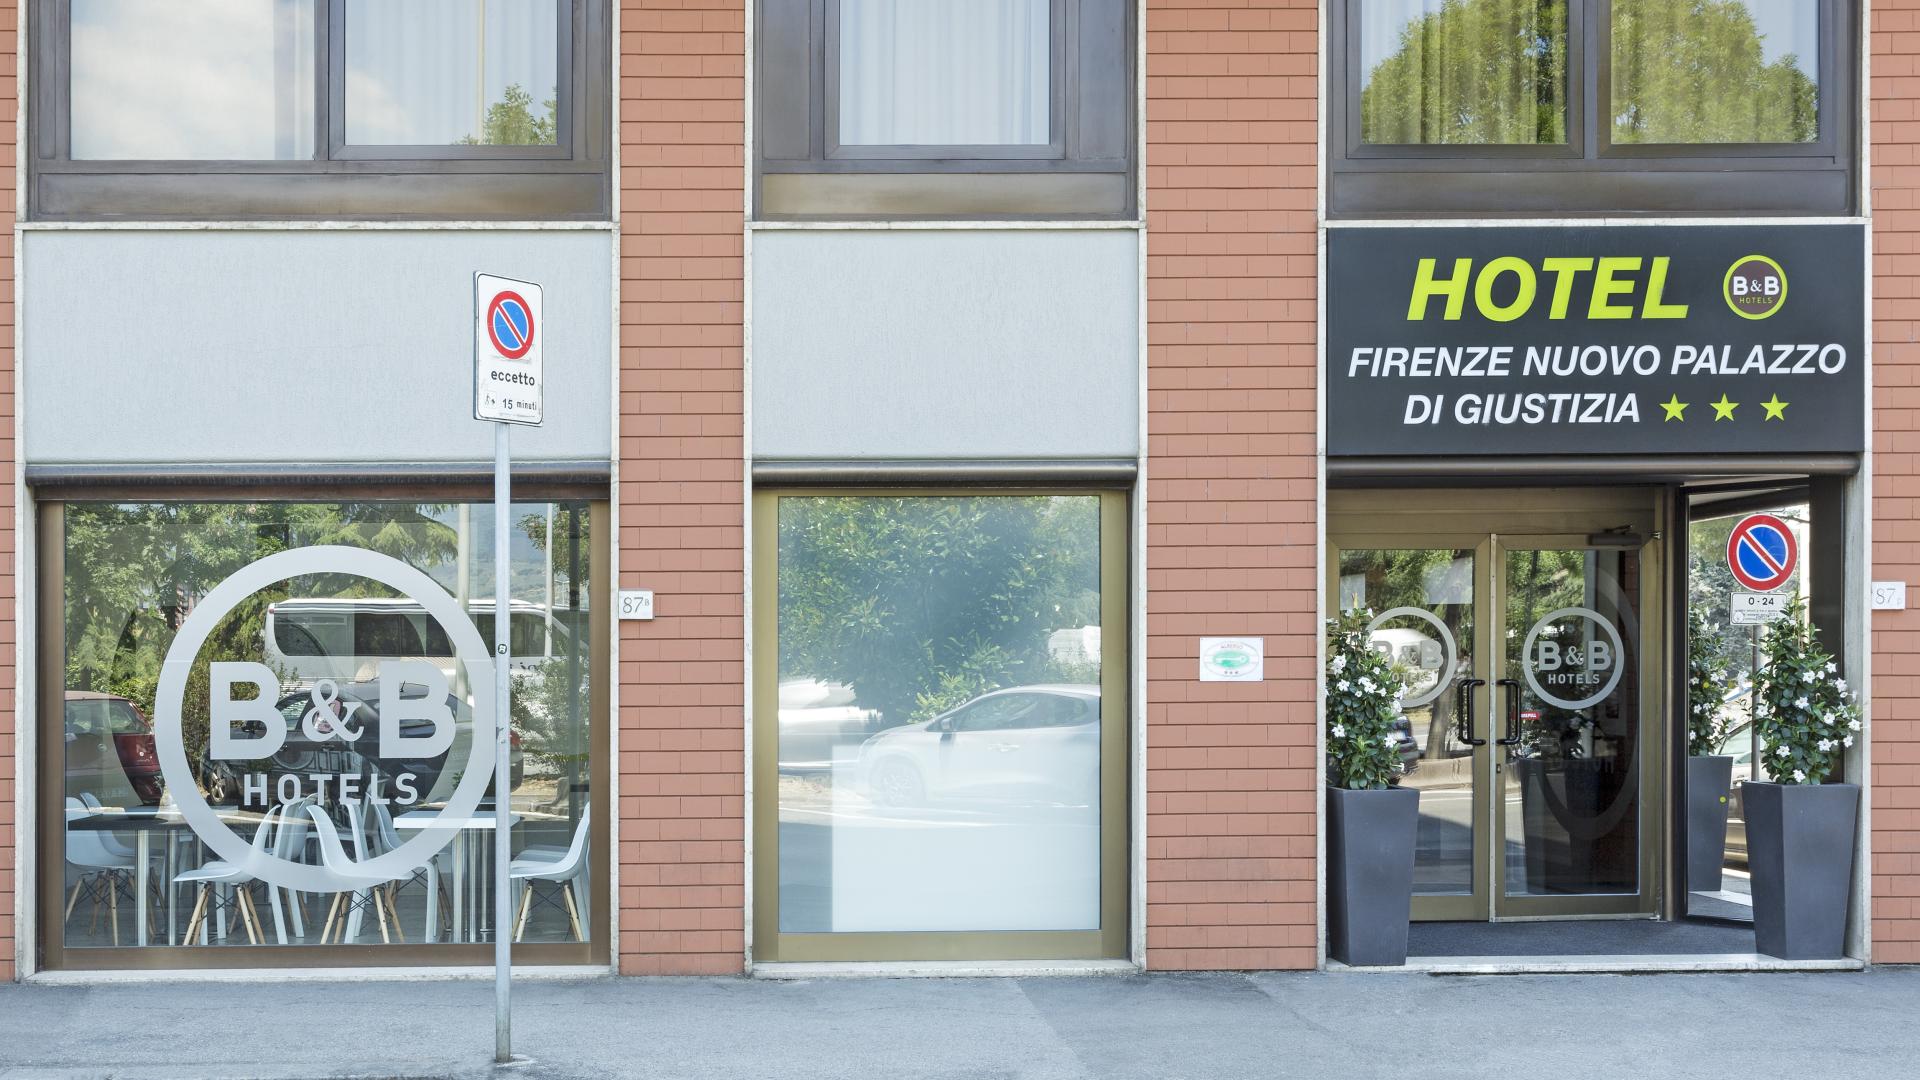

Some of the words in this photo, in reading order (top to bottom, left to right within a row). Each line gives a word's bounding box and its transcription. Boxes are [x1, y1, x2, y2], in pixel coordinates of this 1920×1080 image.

[1407, 256, 1689, 321] HOTEL
[1733, 276, 1780, 295] B&B
[1348, 347, 1513, 377] FIRENZE
[1522, 345, 1661, 376] NUOVO
[1670, 343, 1847, 375] PALAZZO
[491, 370, 535, 385] eccetto
[502, 398, 513, 410] 15
[516, 400, 536, 410] minuti
[1403, 394, 1444, 424] DI
[1454, 392, 1641, 424] GIUSTIZIA
[1538, 640, 1611, 671] B&B
[1391, 672, 1433, 683] OTELS
[1548, 674, 1600, 685] HOTELS
[209, 661, 457, 760] B&B
[243, 773, 418, 805] HOTELS
